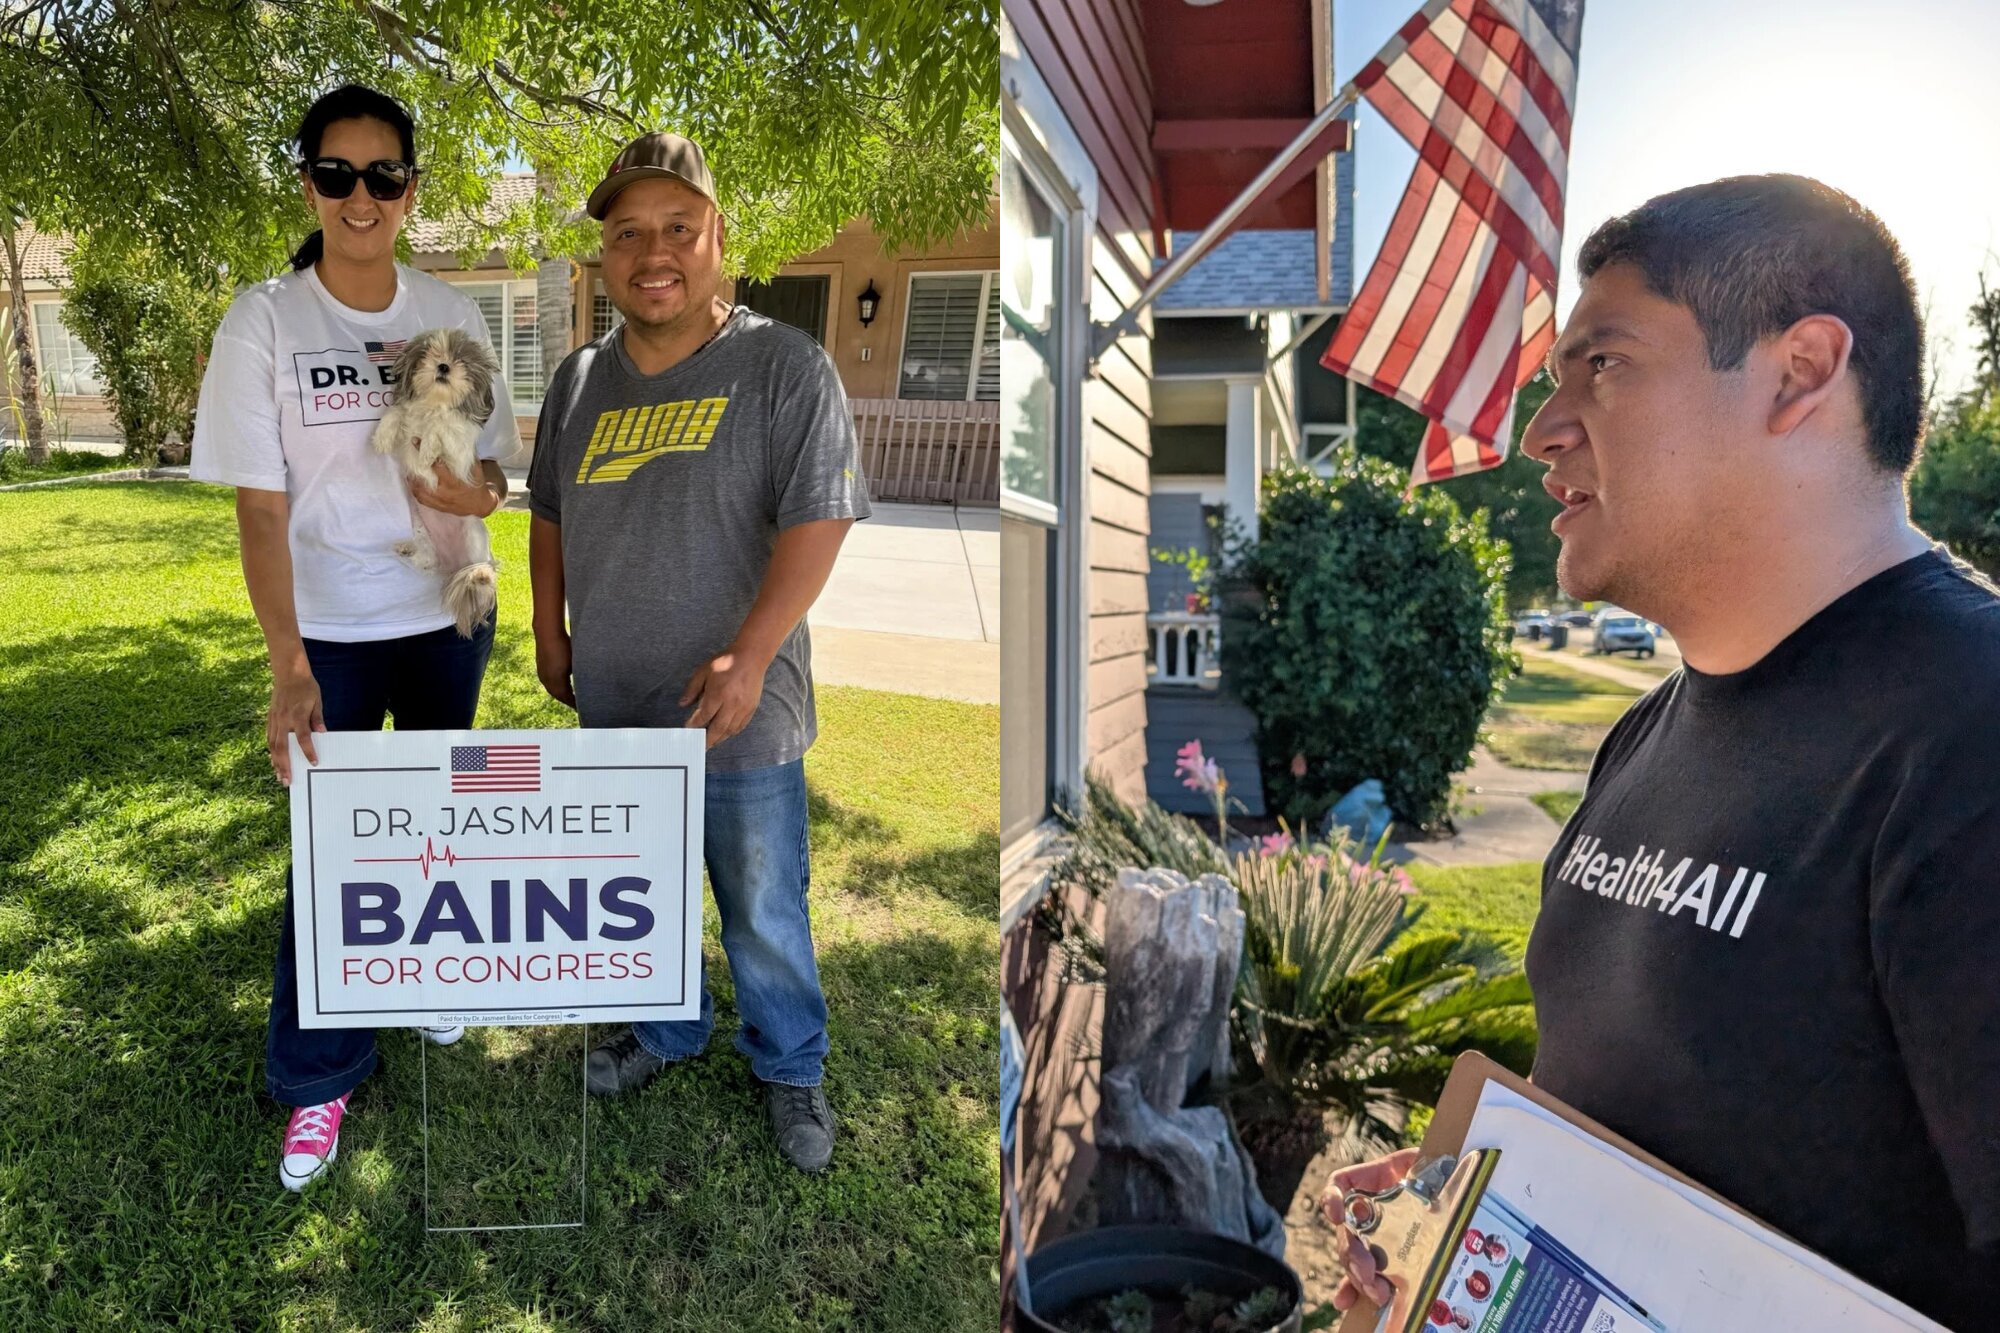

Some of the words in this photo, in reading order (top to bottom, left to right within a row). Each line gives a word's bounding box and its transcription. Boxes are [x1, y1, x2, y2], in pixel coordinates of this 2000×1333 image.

[310, 365, 369, 389] DR.
[315, 392, 360, 412] FOR
[576, 397, 729, 484] PUMA
[353, 808, 423, 838] DR.
[439, 805, 640, 836] JASMEET
[1557, 834, 1768, 939] #Health4All
[341, 877, 655, 946] BAINS
[343, 957, 422, 985] FOR
[435, 952, 653, 984] CONGRESS
[533, 1013, 560, 1021] Congress
[1504, 1289, 1514, 1299] IS
[1508, 1268, 1525, 1292] RANDY
[1490, 1296, 1511, 1328] PROUDLY
